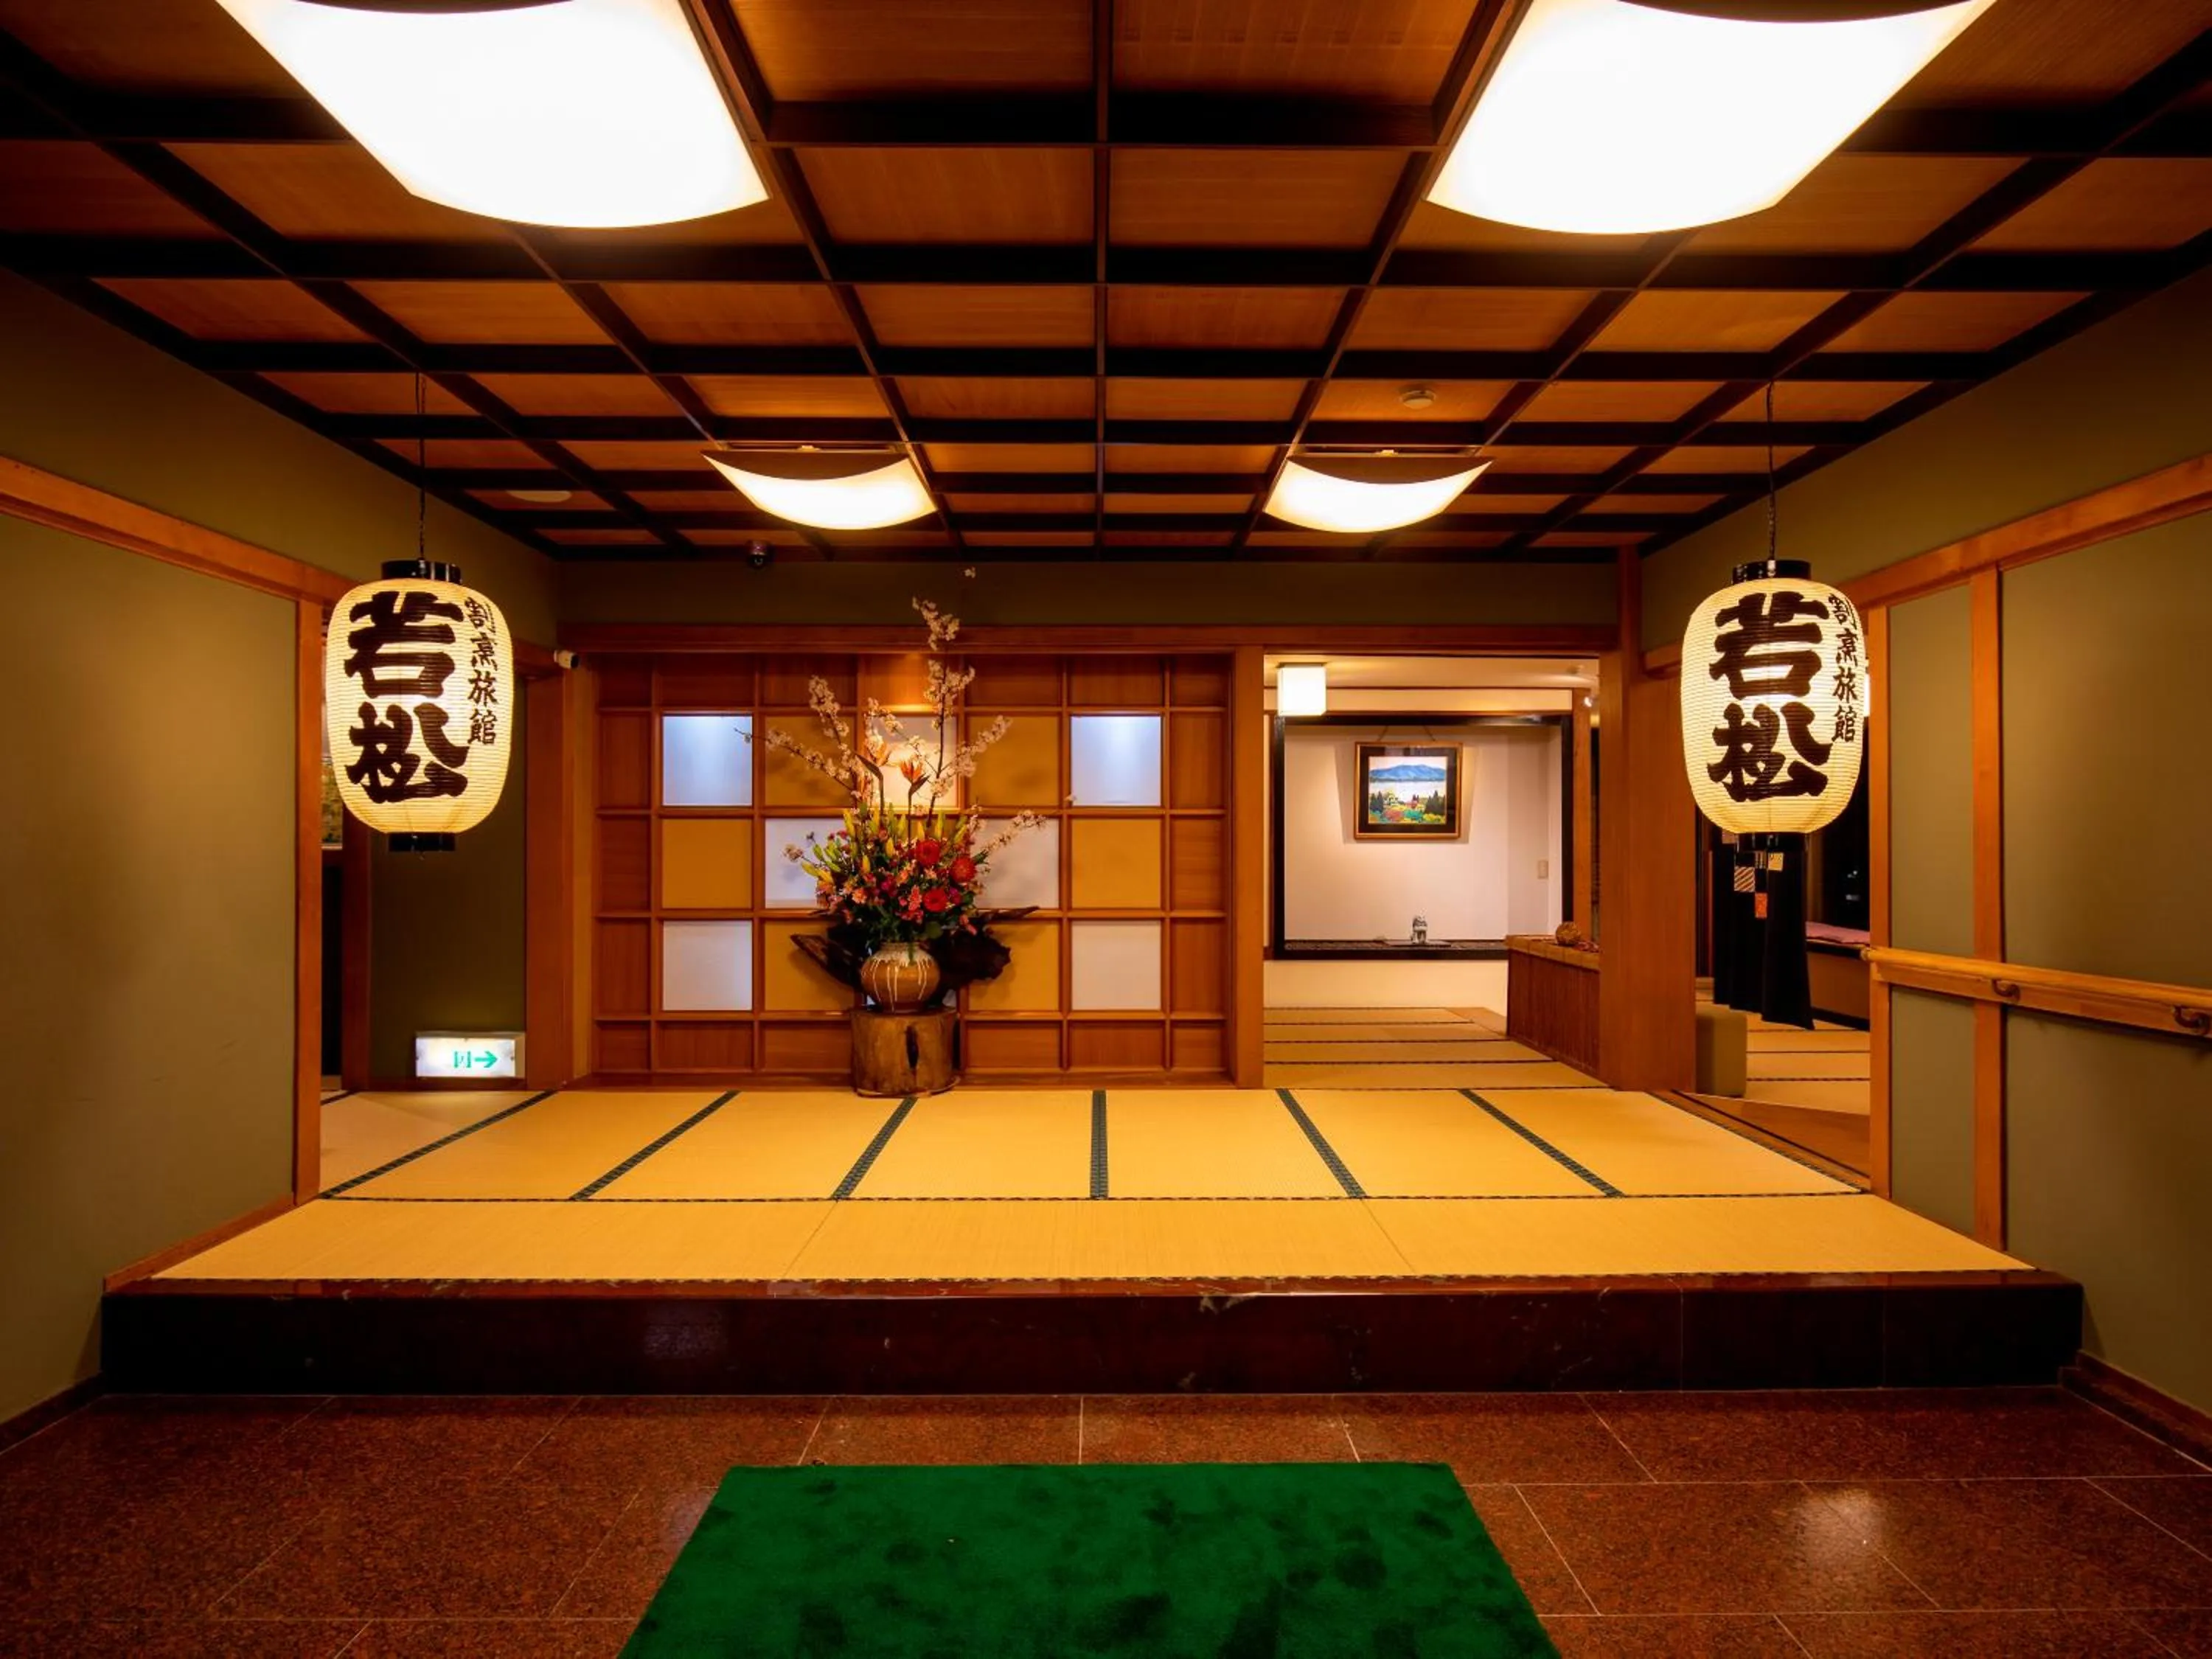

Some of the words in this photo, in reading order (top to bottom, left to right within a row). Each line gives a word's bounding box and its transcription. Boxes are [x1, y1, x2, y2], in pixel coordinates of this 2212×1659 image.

[345, 591, 469, 802] 若松
[465, 597, 498, 745] 割烹旅館
[1707, 591, 1832, 801] 若松
[1828, 594, 1857, 742] 割烹旅館
